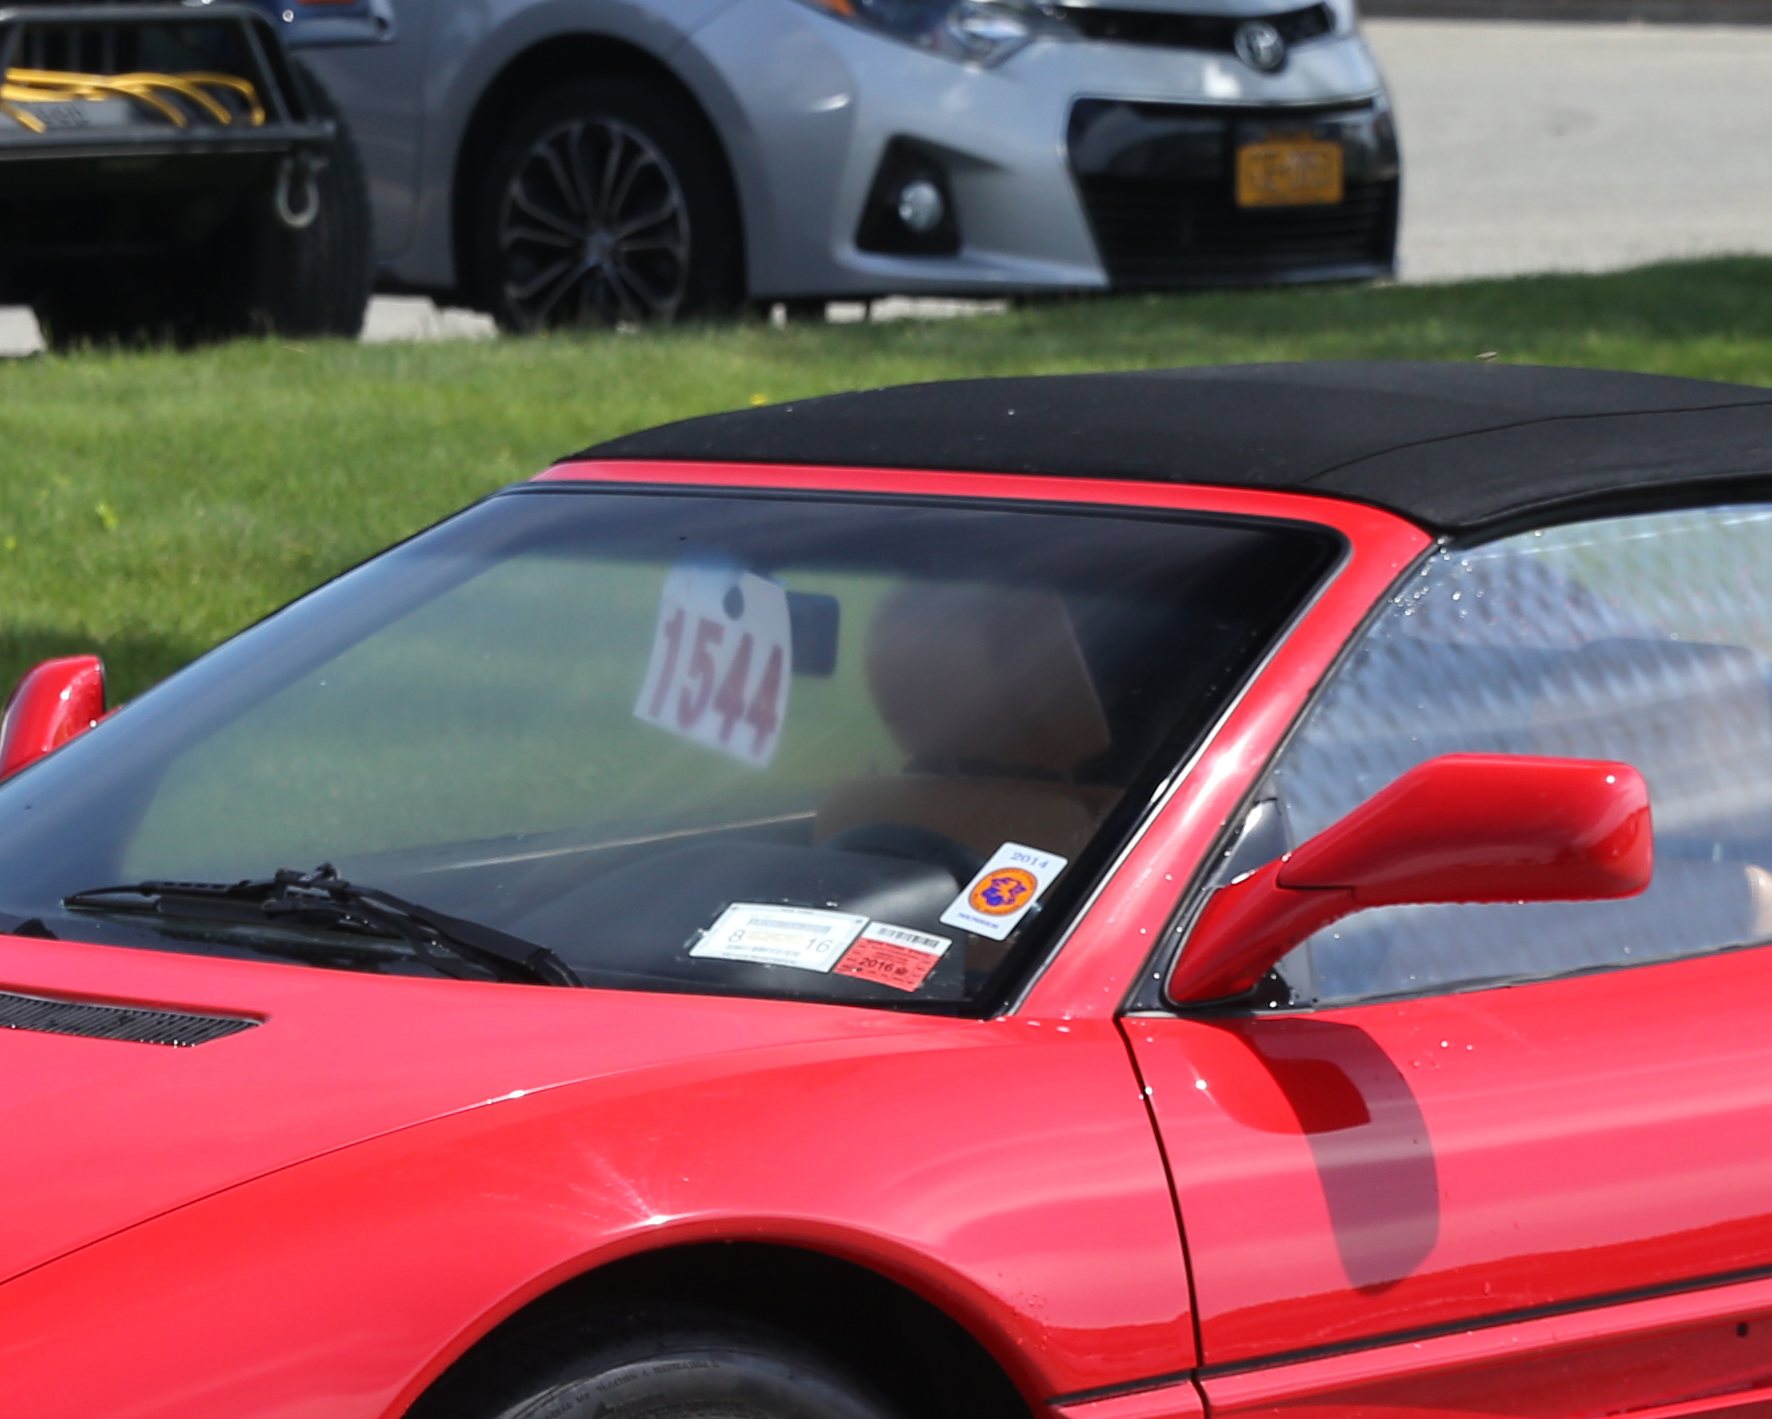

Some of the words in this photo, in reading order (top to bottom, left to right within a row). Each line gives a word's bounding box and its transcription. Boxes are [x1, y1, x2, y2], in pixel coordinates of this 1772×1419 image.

[648, 607, 785, 757] 1544
[1010, 851, 1050, 869] 2014
[728, 929, 744, 944] 8
[805, 937, 833, 954] 16
[859, 957, 895, 972] 2016
